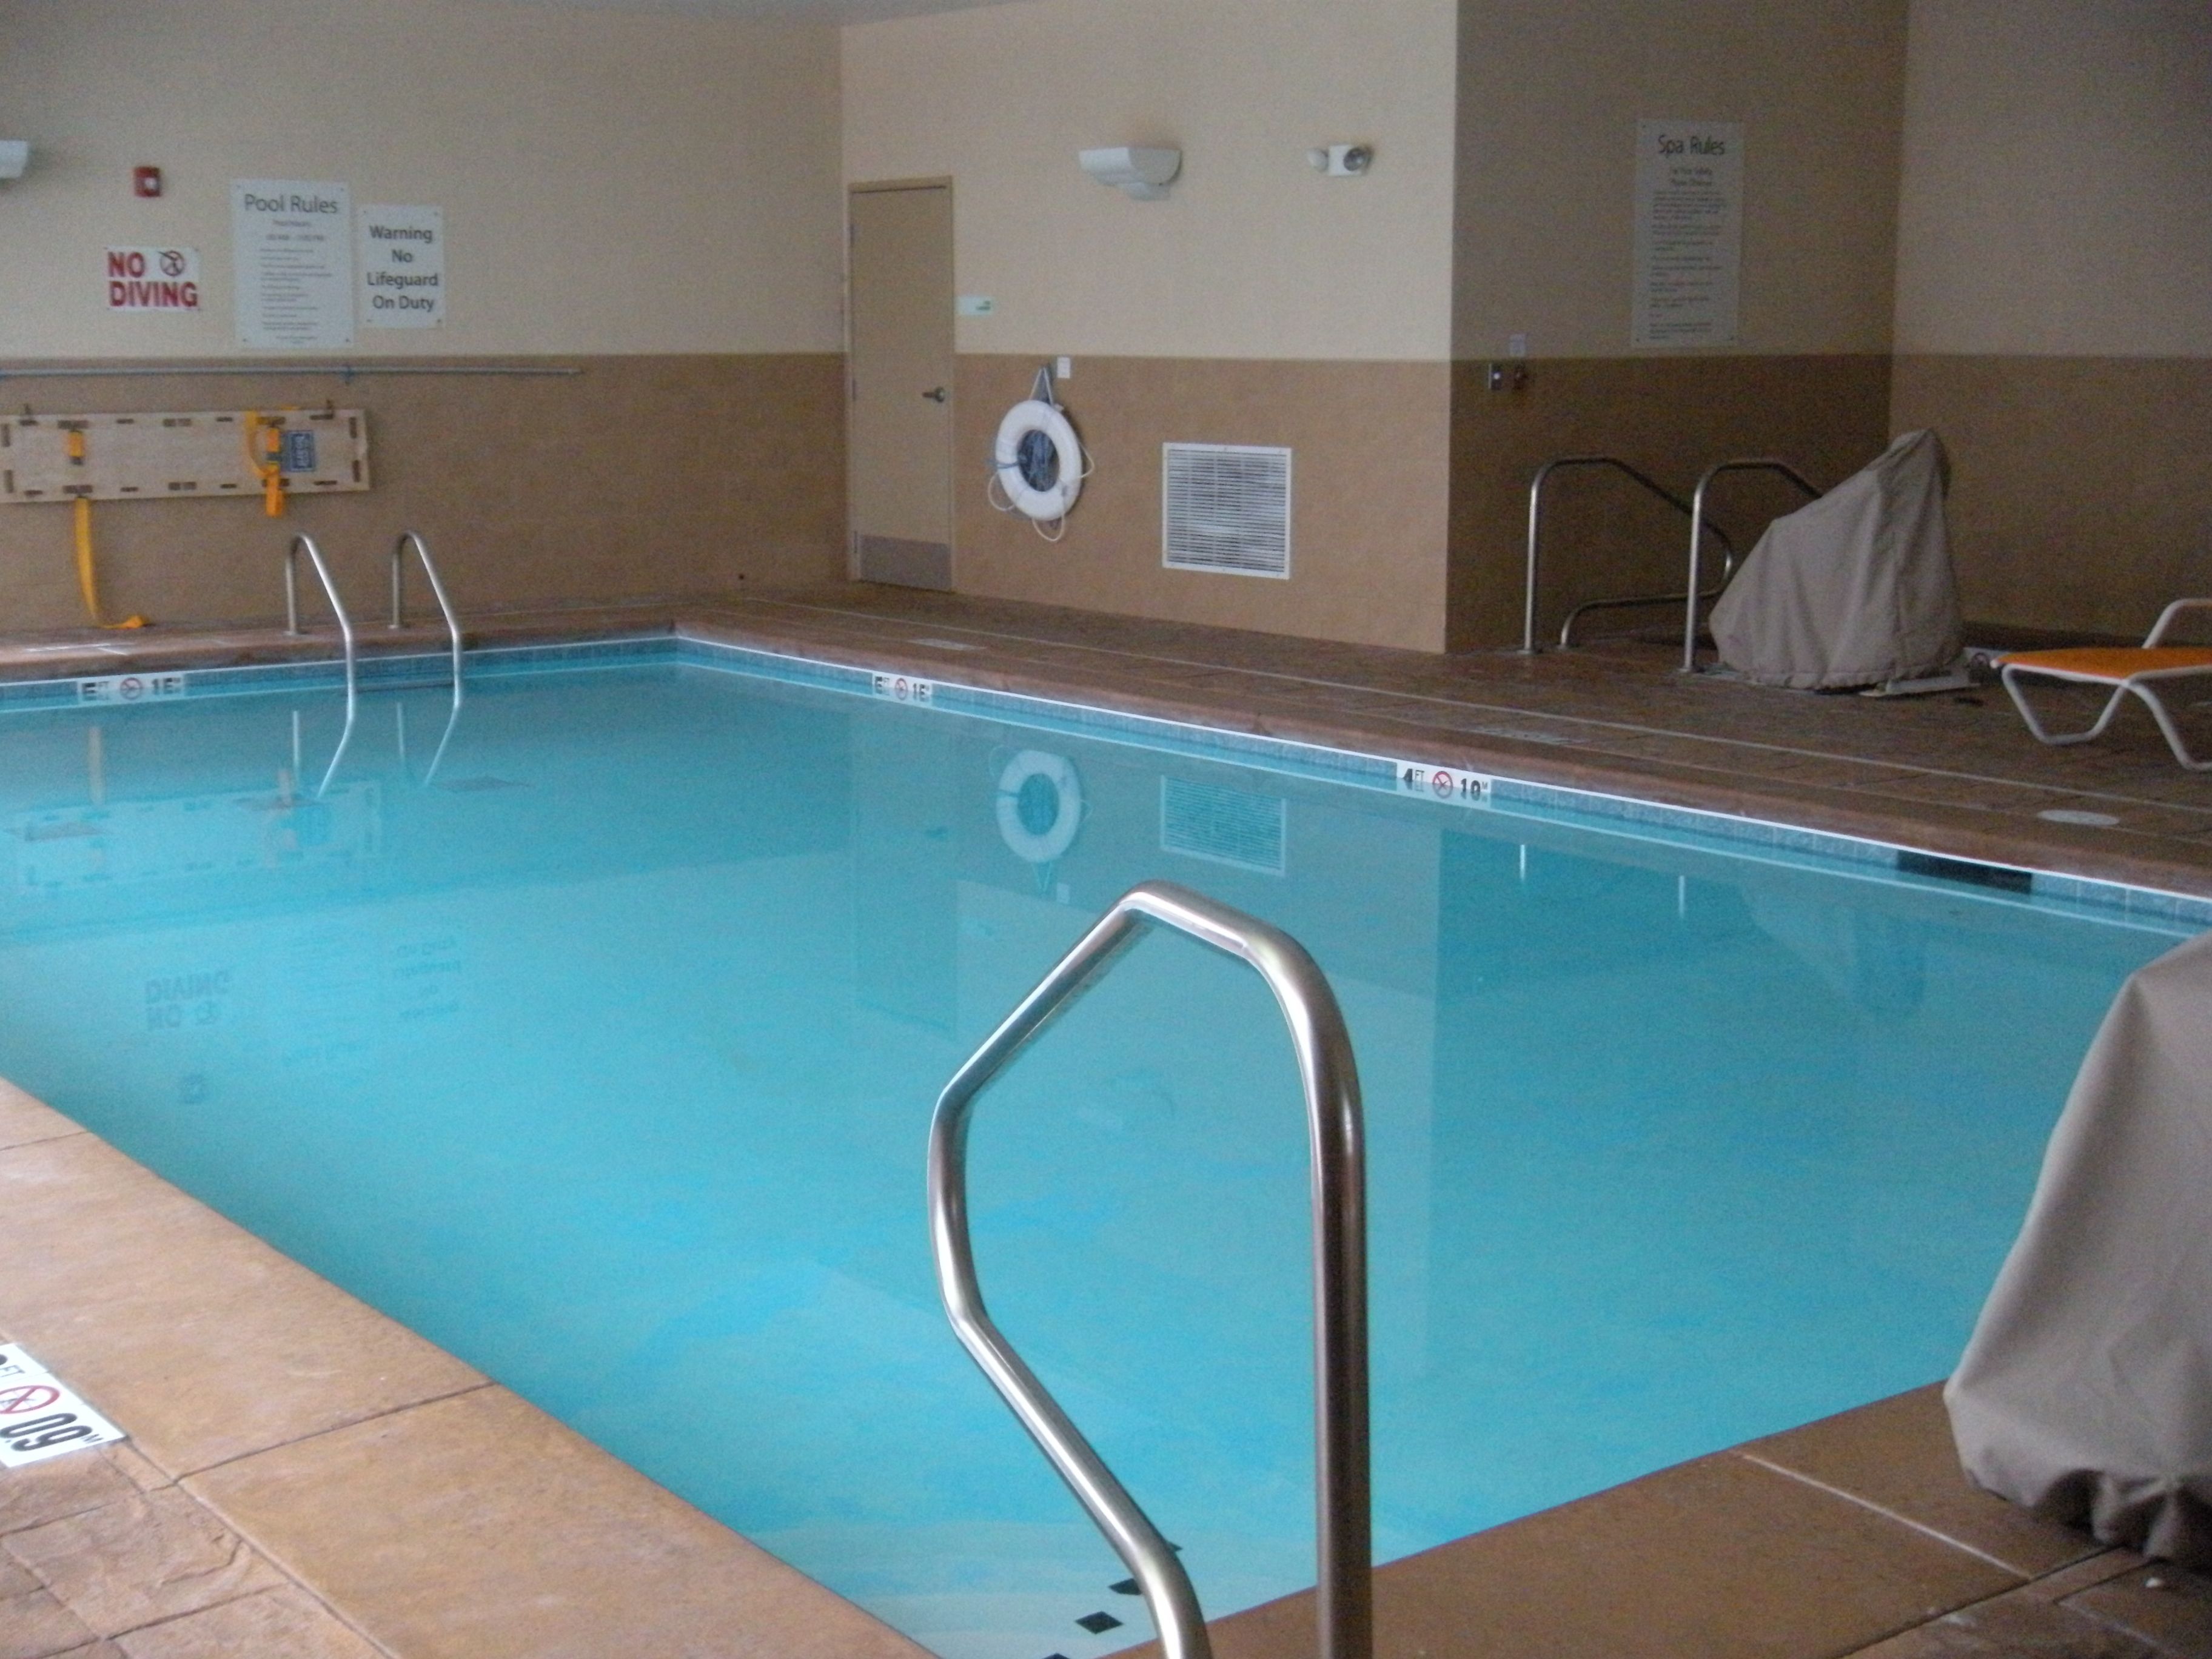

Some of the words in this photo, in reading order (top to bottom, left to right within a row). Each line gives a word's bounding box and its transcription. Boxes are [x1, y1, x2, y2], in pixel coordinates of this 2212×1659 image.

[1658, 135, 1684, 158] Spa
[1690, 135, 1725, 155] Rules
[244, 193, 284, 212] Pool
[290, 195, 338, 213] Rules
[369, 225, 433, 244] Warning
[108, 252, 146, 278] NO
[391, 249, 414, 263] No
[367, 272, 439, 290] Lifeguard
[109, 281, 198, 307] DIVING
[372, 295, 394, 309] On
[399, 295, 435, 313] Duty
